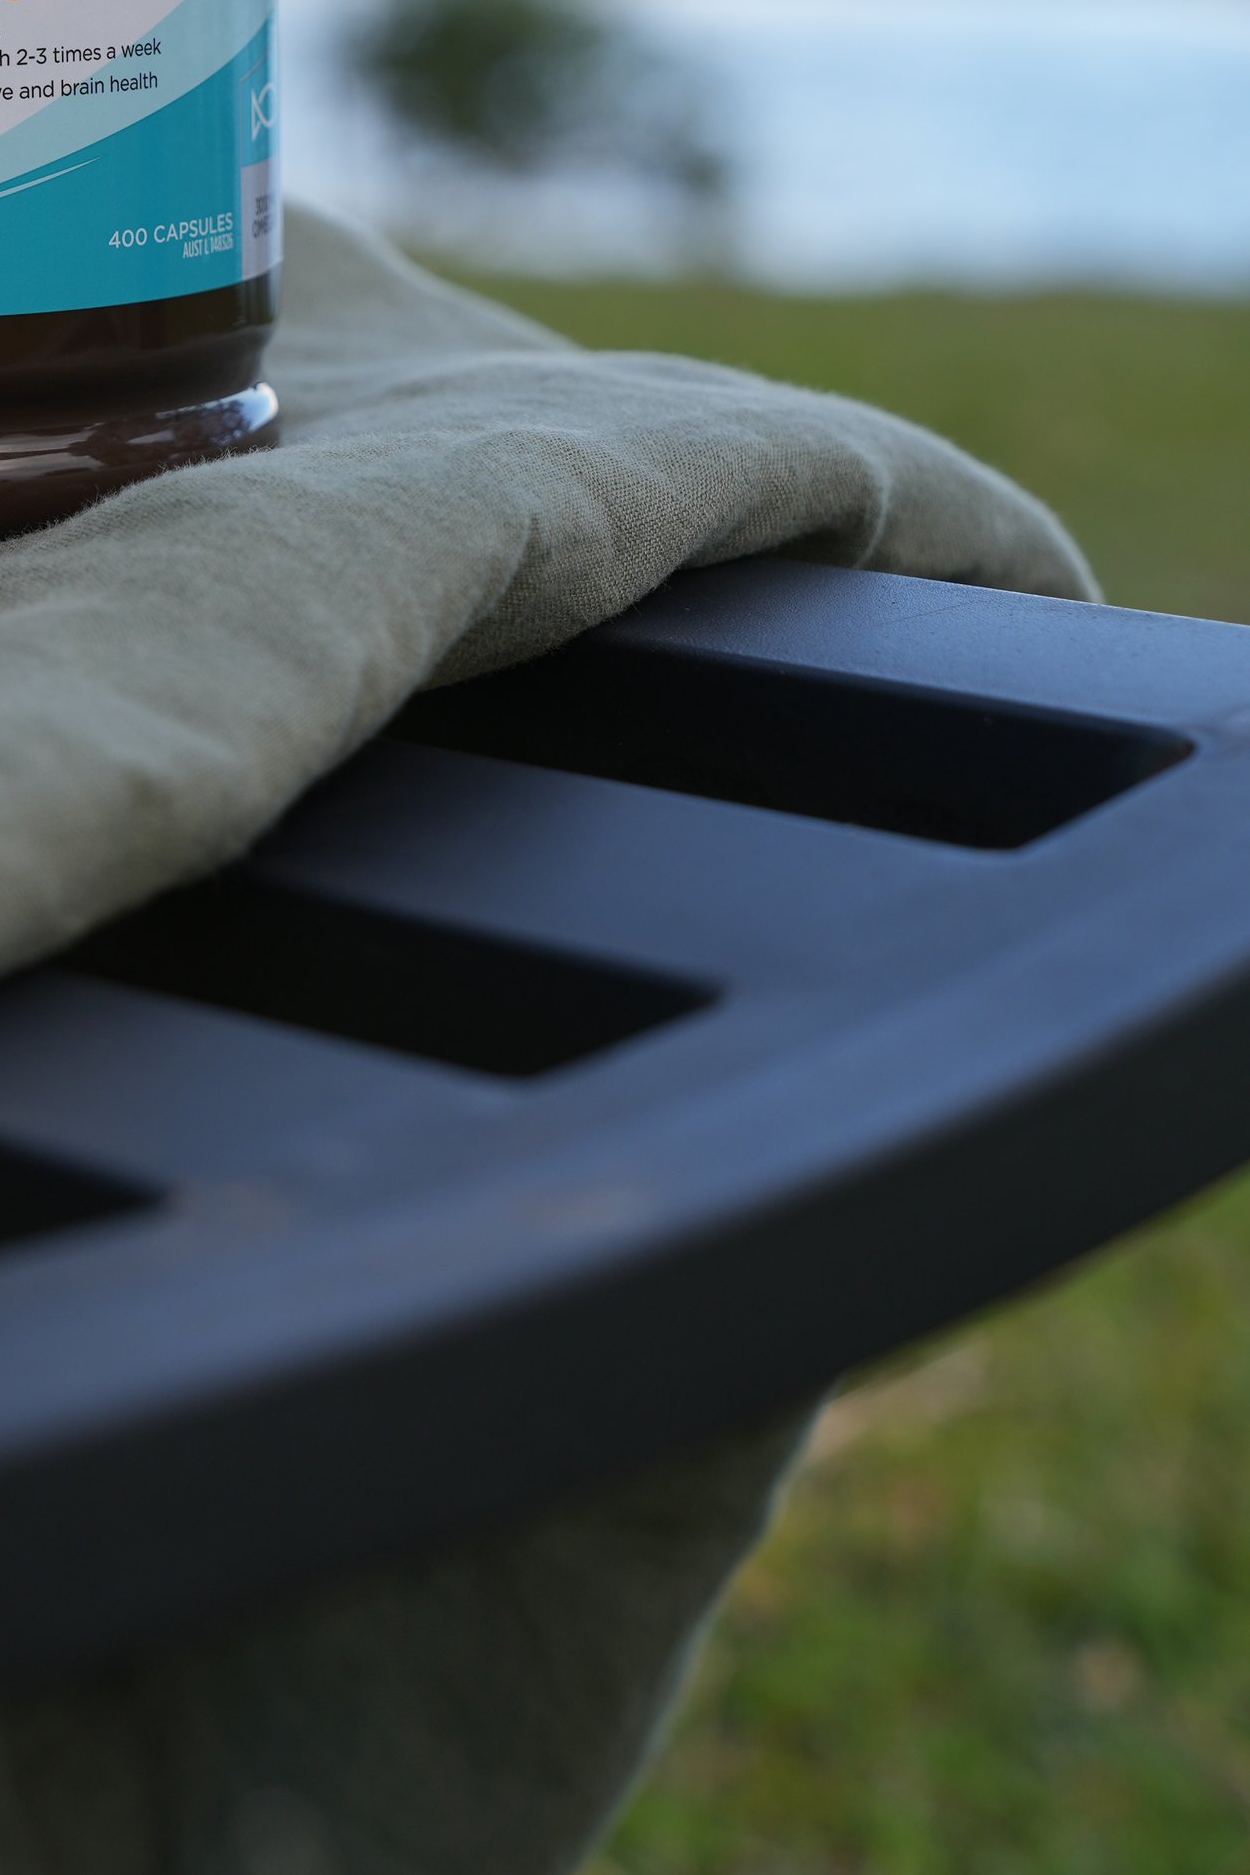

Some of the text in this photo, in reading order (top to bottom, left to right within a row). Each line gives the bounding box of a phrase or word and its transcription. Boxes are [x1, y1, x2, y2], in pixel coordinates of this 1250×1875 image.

[17, 48, 47, 65] 2-3
[53, 46, 101, 63] times
[107, 47, 115, 59] a
[122, 38, 161, 58] week
[20, 81, 54, 99] and
[61, 78, 104, 97] brain
[111, 72, 157, 91] health
[109, 228, 147, 248] 400
[154, 213, 233, 243] CAPSULES
[183, 240, 202, 258] AUST
